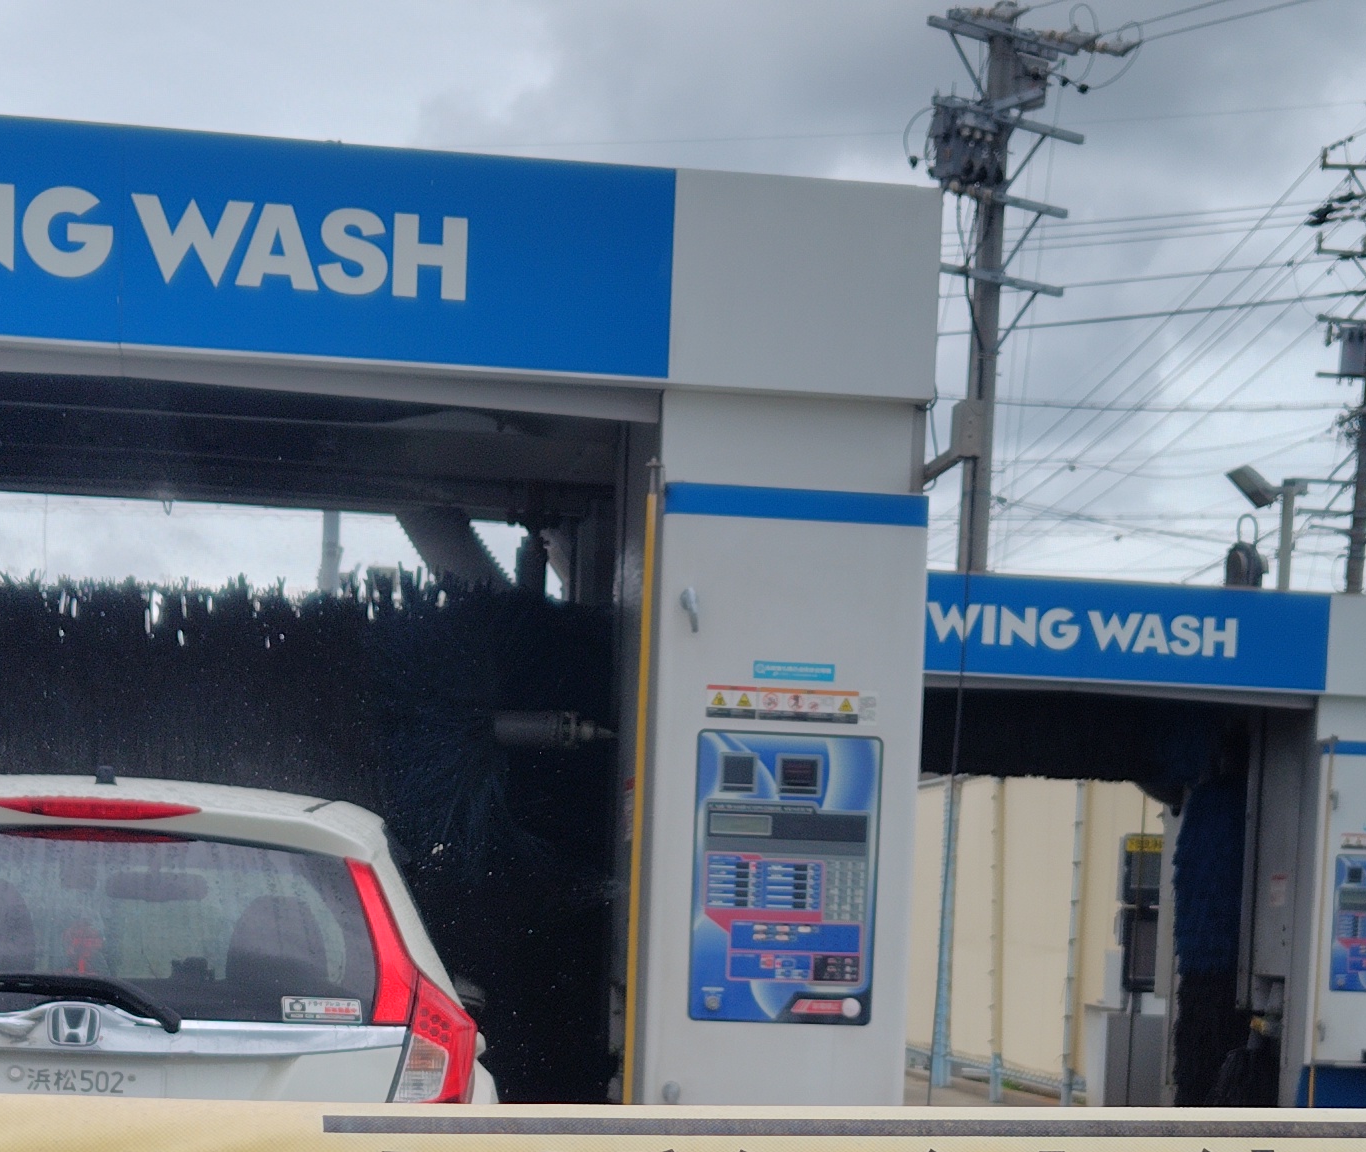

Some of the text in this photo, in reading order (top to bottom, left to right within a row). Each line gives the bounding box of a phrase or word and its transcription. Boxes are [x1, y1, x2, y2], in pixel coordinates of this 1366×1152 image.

[131, 193, 469, 301] WASH
[927, 601, 1238, 659] WING WASH
